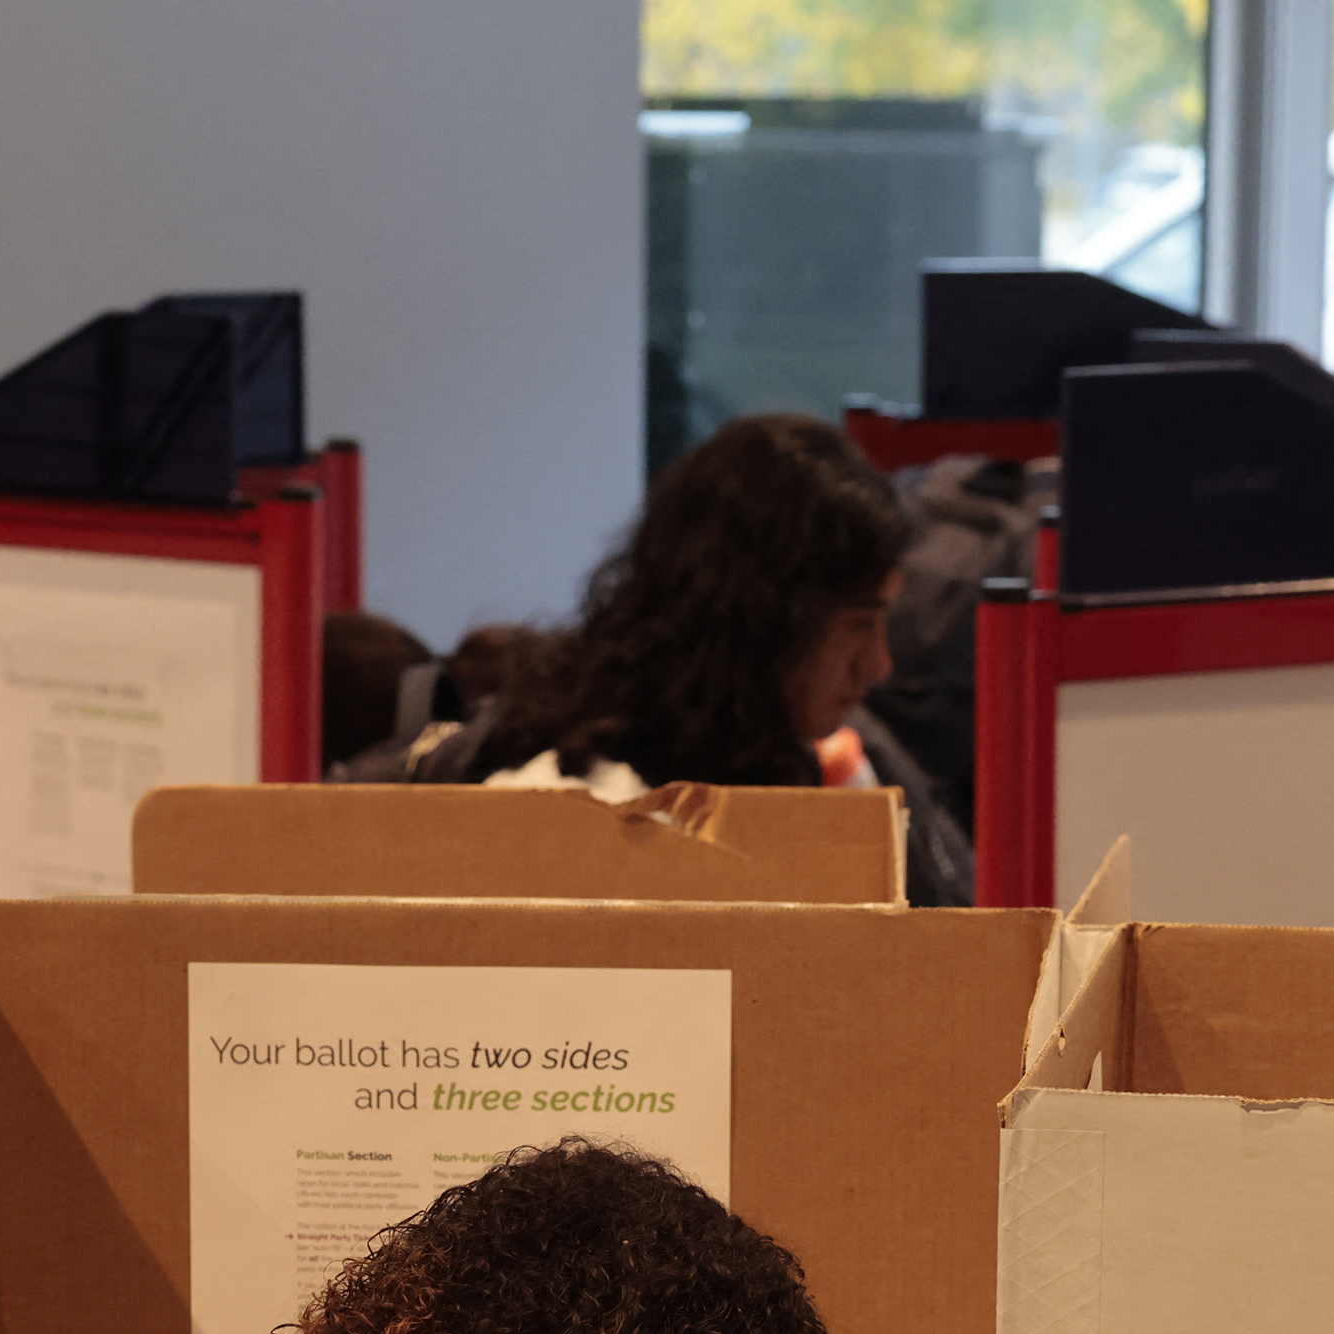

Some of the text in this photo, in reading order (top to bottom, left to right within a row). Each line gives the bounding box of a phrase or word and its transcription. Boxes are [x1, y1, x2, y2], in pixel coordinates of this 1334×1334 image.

[210, 1036, 630, 1070] Your ballot has two sides
[354, 1082, 676, 1113] and three sections
[296, 1149, 392, 1161] Partisan Section
